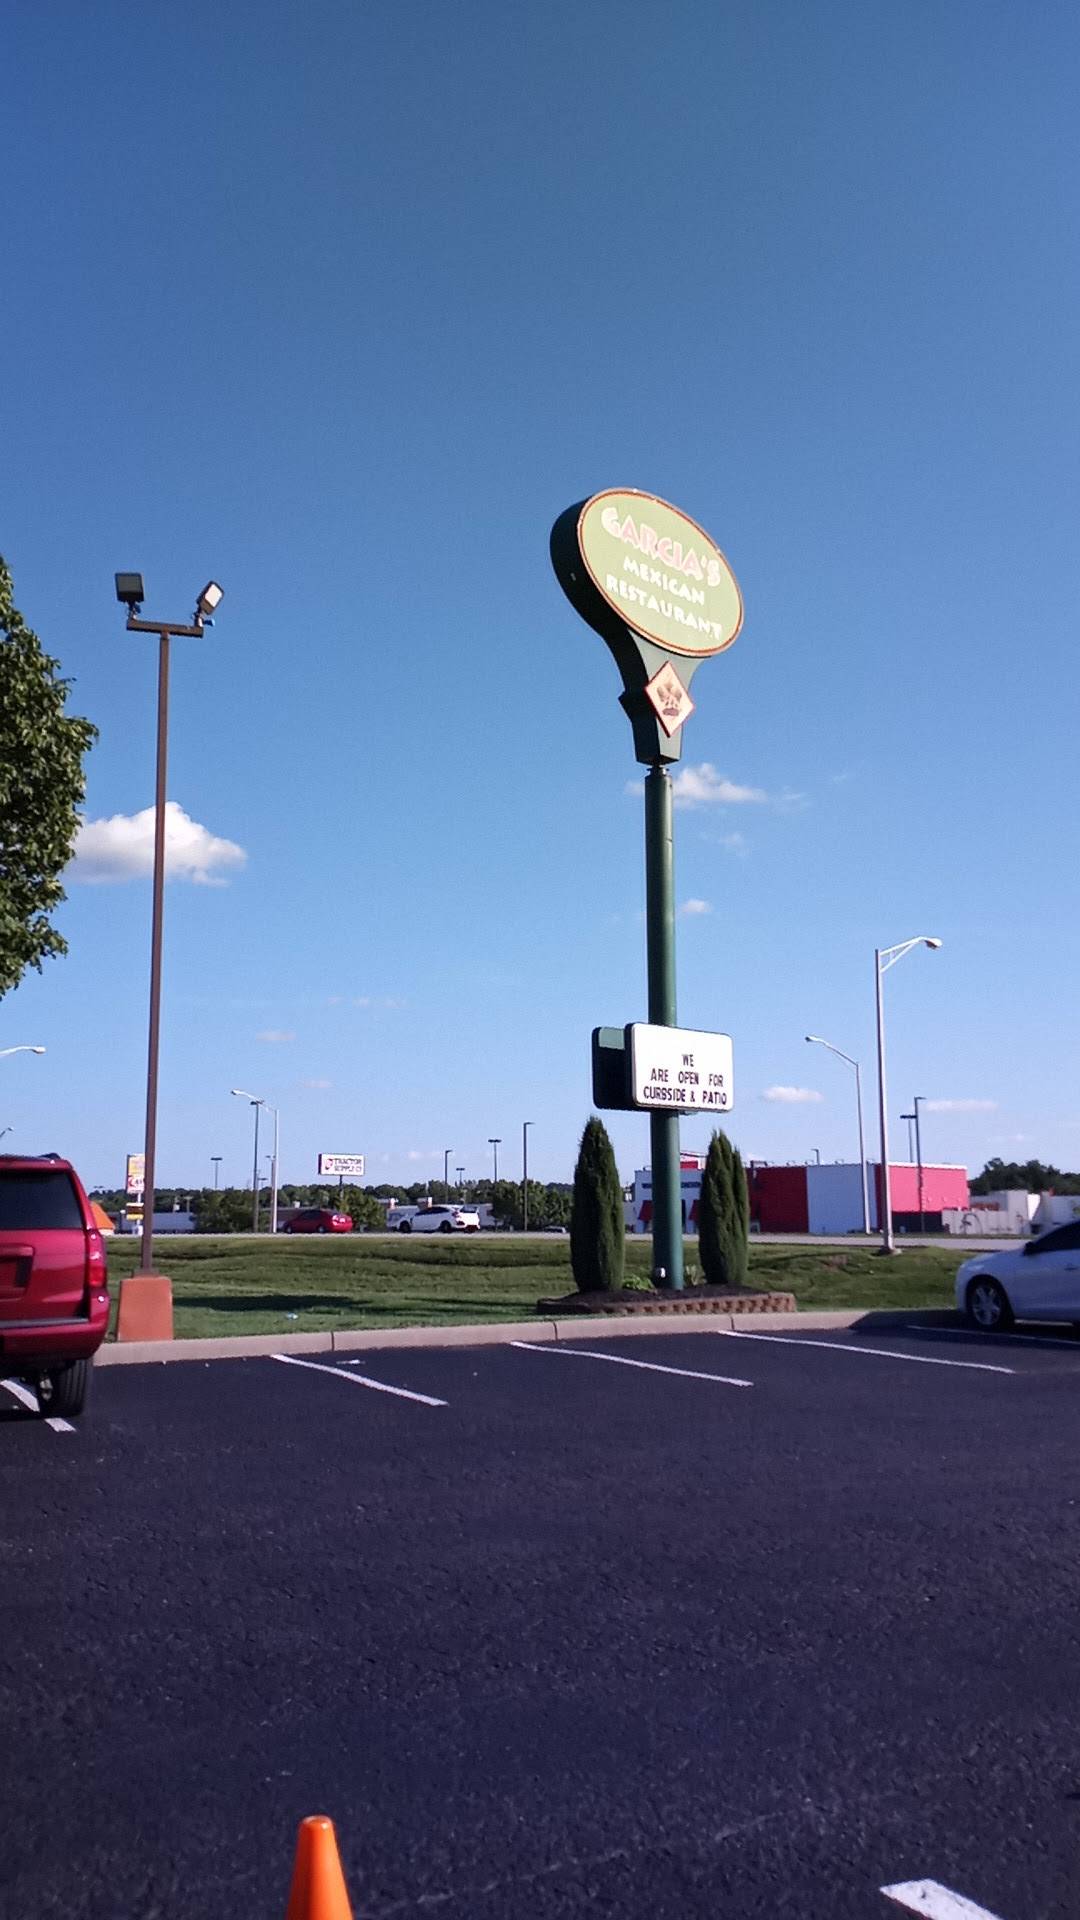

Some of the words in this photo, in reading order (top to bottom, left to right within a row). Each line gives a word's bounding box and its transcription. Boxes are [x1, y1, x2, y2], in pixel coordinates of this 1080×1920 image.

[601, 507, 721, 587] GARCIA'S
[623, 556, 705, 606] MEXICAN
[606, 574, 722, 640] RESTAURANT
[650, 1068, 669, 1083] ARE
[678, 1071, 699, 1085] OPEN
[708, 1073, 724, 1087] FOR
[682, 1054, 694, 1067] WE
[643, 1086, 686, 1102] CURBSIDE
[690, 1091, 696, 1102] &
[702, 1090, 728, 1105] PATIO
